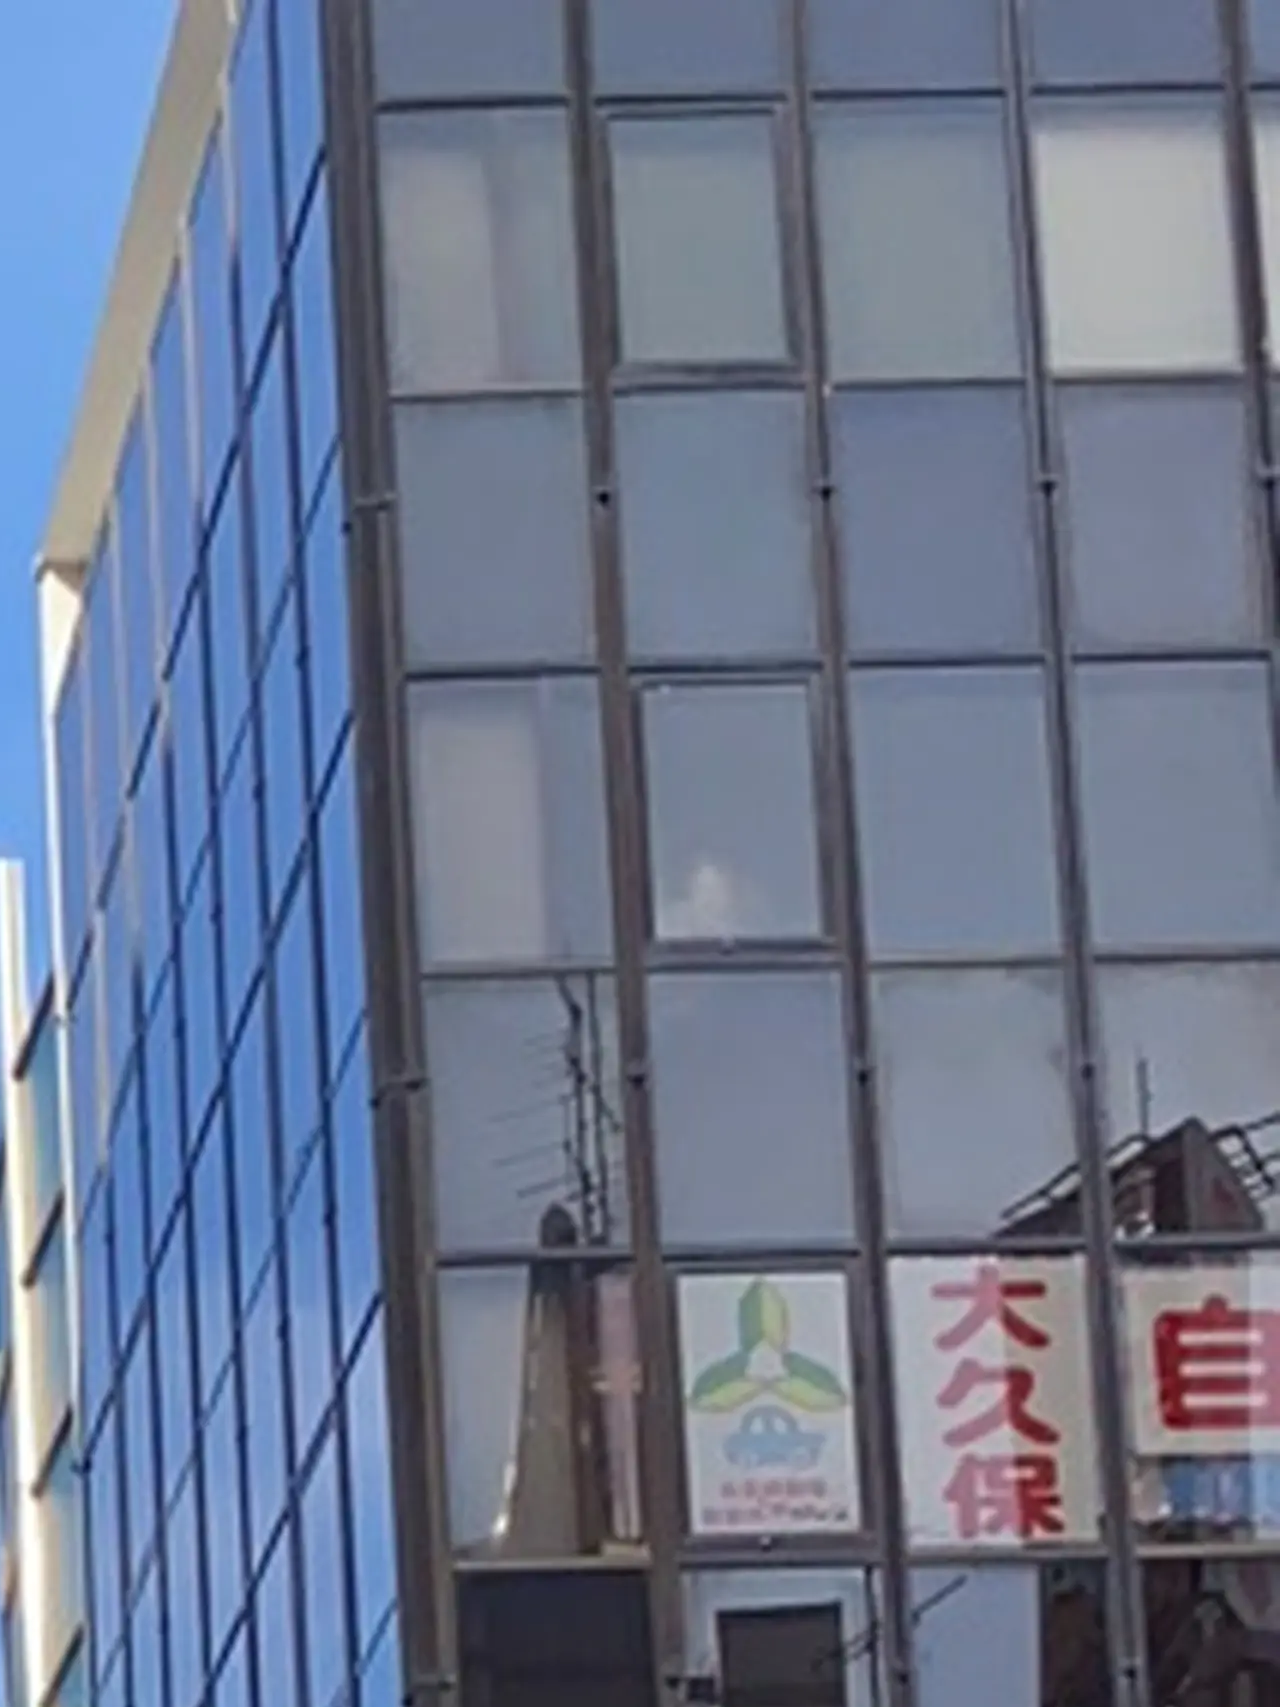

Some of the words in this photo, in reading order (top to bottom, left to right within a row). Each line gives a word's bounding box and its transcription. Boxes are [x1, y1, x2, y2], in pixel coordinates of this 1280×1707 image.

[930, 1264, 1064, 1540] 大久保
[1153, 1293, 1280, 1432] 自
